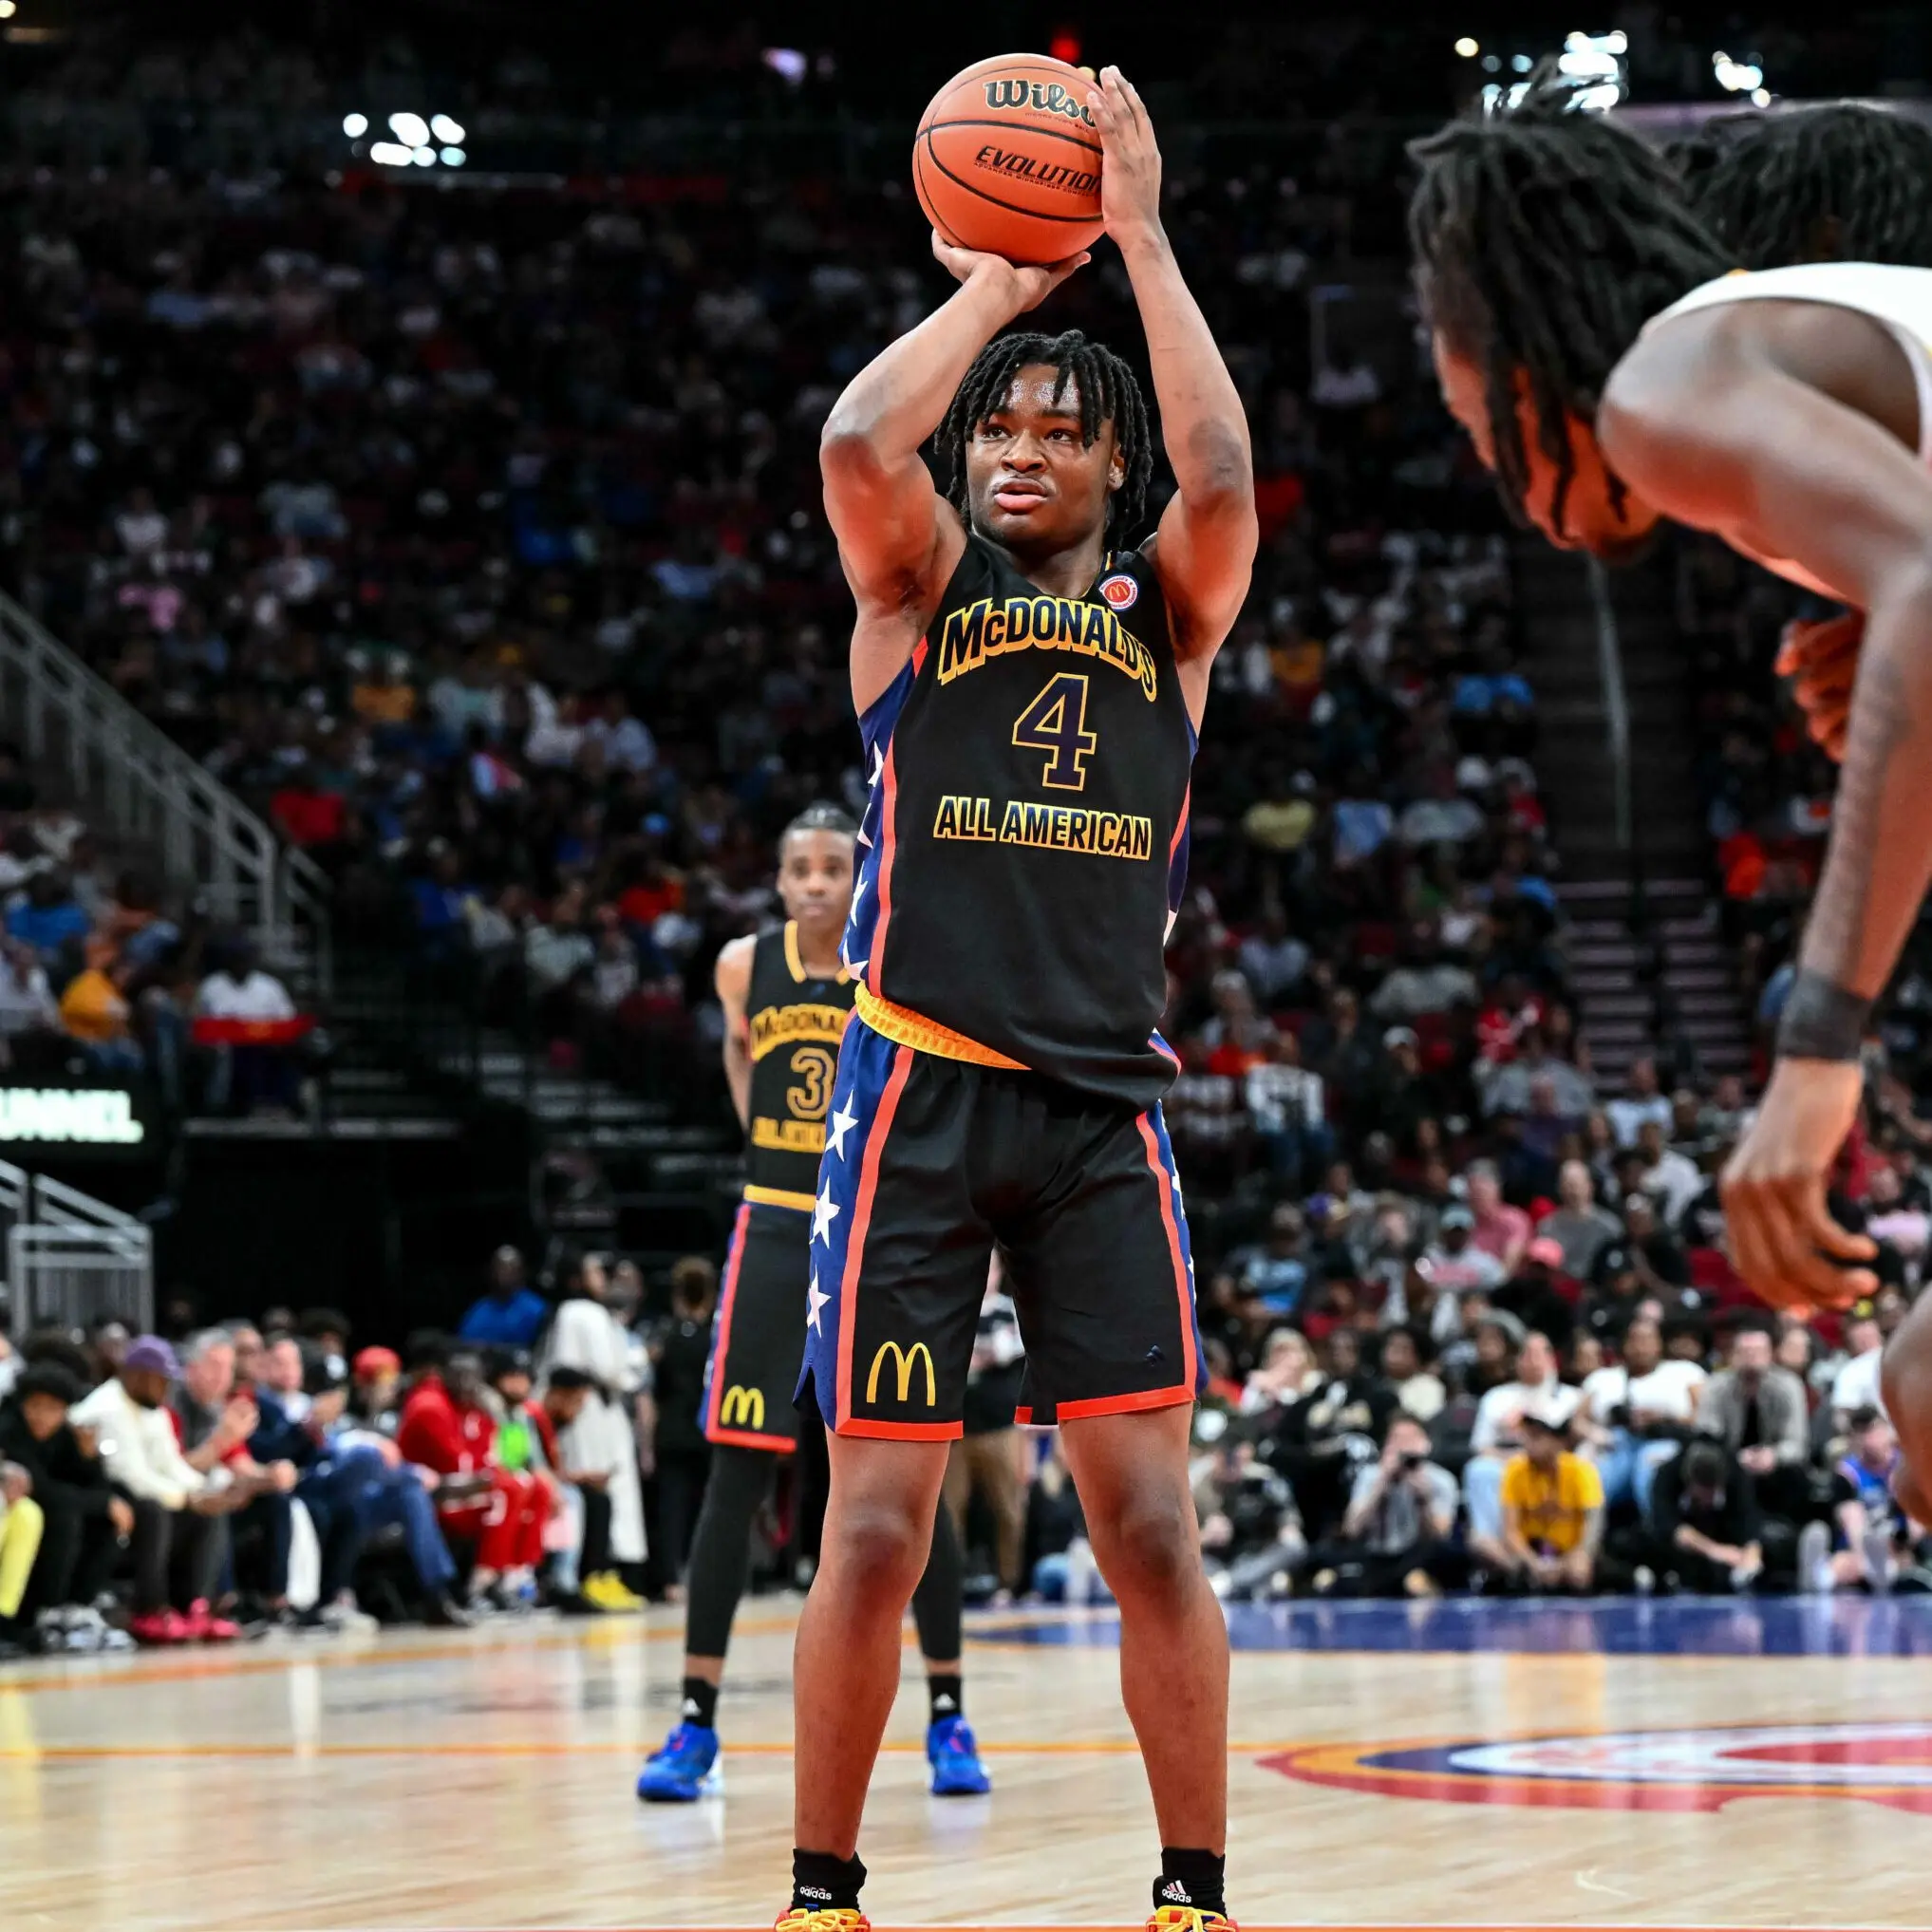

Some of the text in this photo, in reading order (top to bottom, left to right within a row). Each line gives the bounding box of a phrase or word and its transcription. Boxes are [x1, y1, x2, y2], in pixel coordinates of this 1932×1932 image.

[1011, 672, 1097, 791] 4
[933, 796, 1152, 860] ALL AMERICAN
[787, 1047, 835, 1119] 3
[799, 1885, 833, 1901] adidas
[1161, 1887, 1192, 1904] adidas
